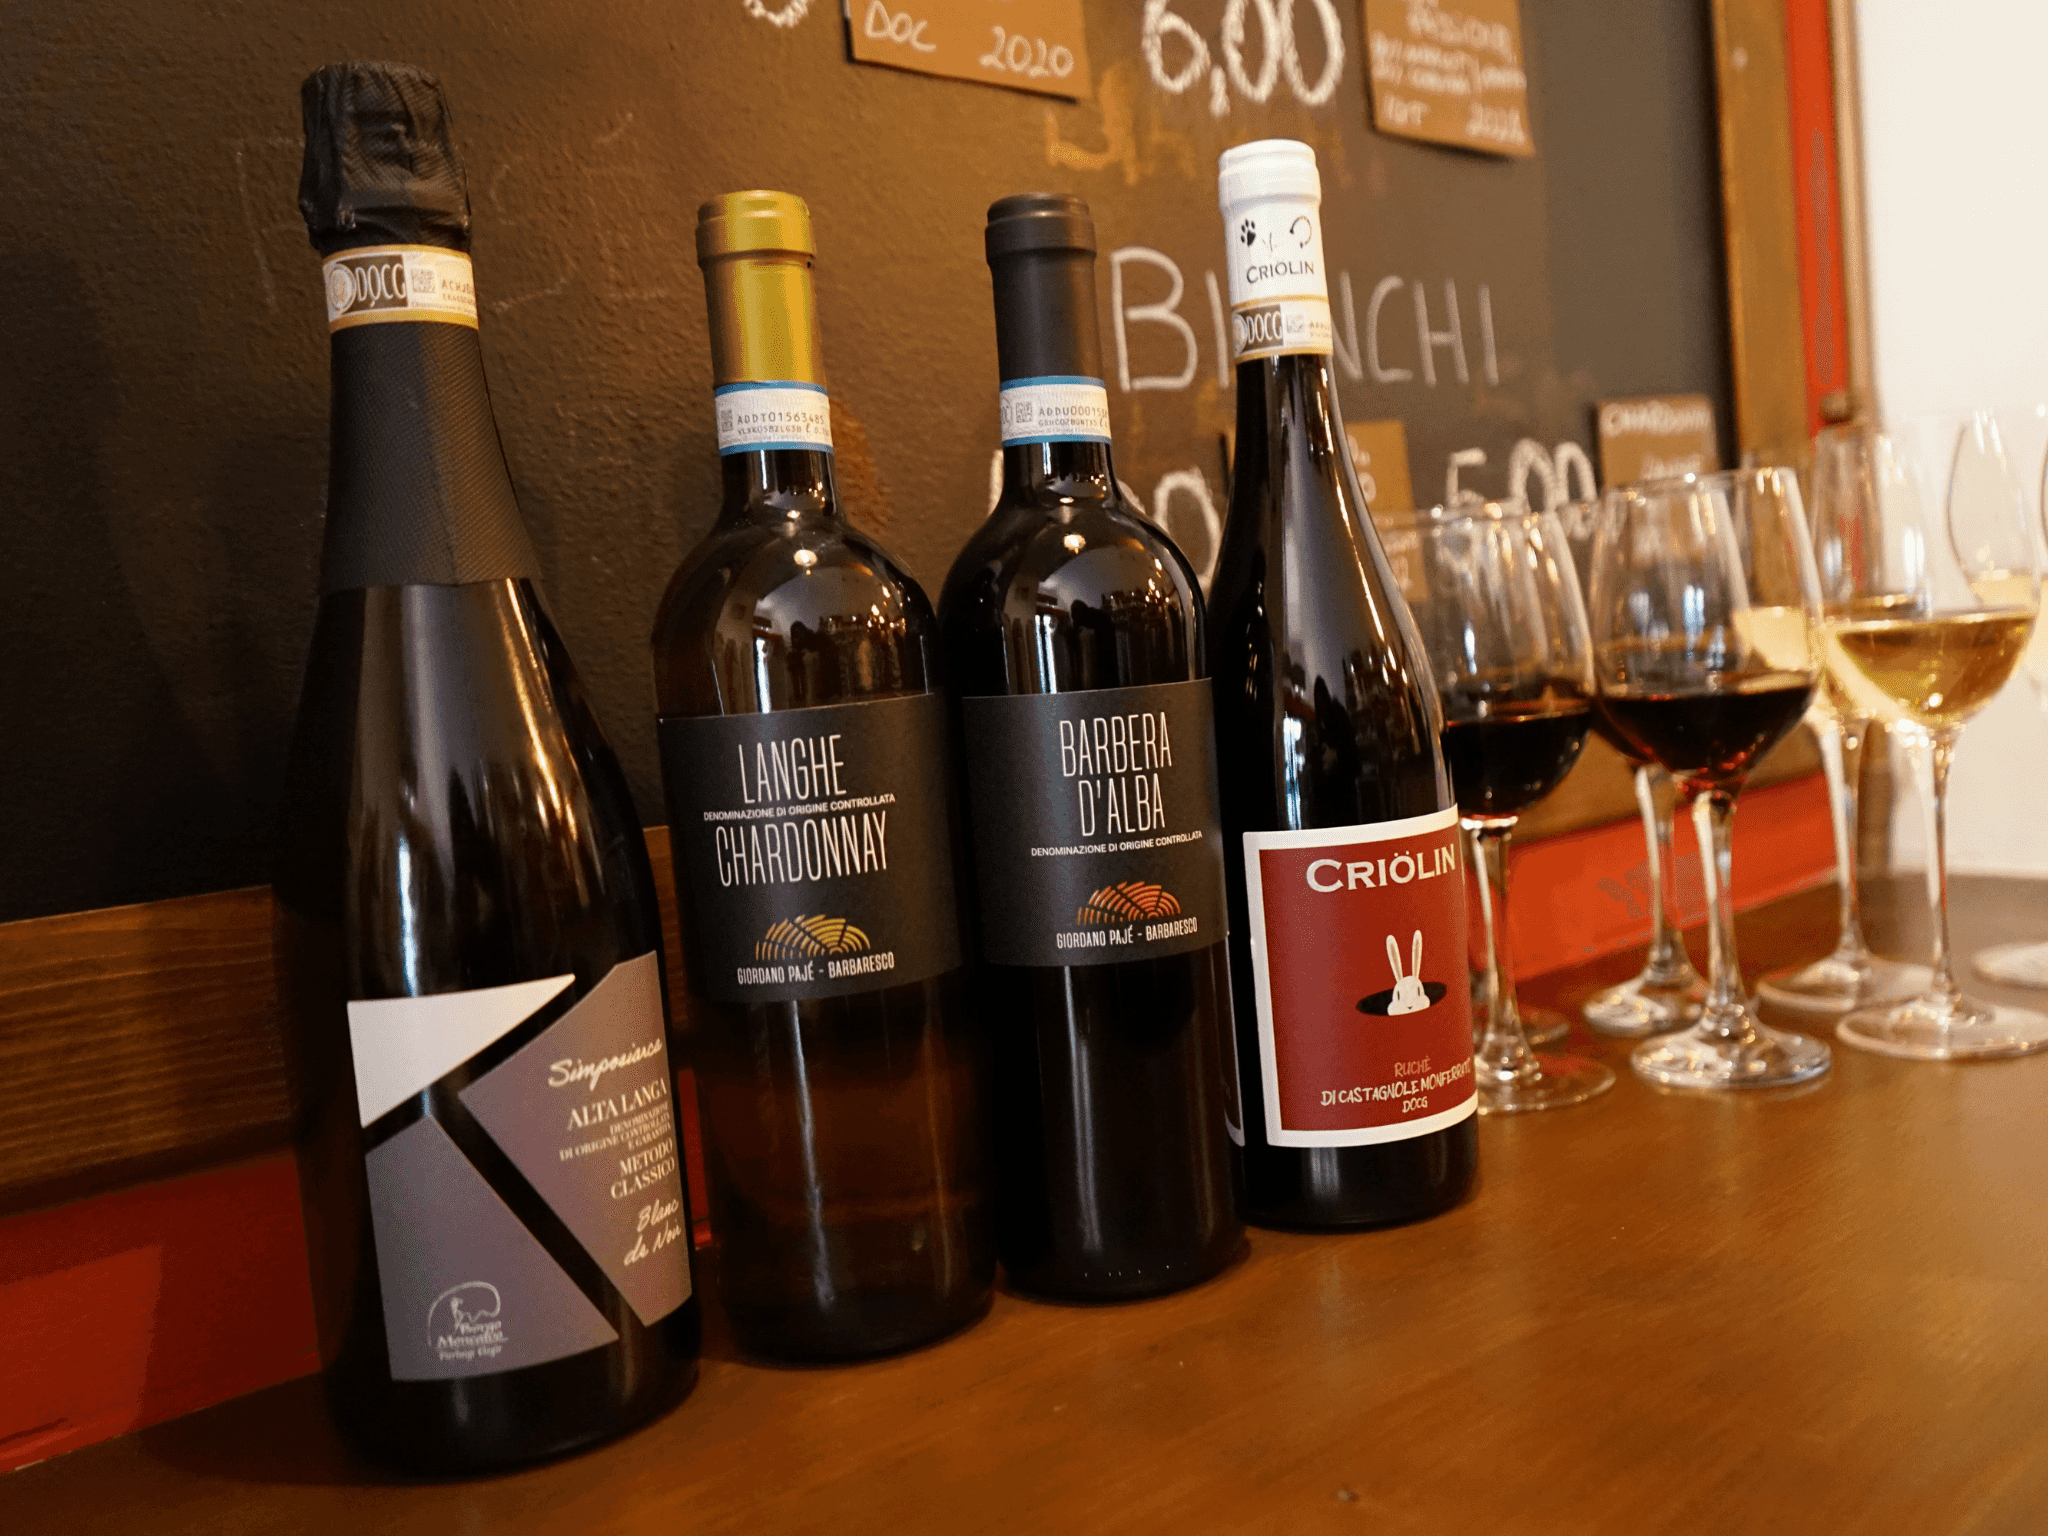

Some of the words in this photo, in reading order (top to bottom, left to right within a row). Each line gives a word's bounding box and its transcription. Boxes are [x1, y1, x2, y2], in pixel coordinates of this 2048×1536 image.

[865, 0, 936, 52] DOC
[978, 25, 1075, 78] 2020
[1142, 0, 1346, 118] 6,00
[355, 263, 408, 303] DOCG
[1246, 261, 1315, 284] CRIOLIN
[1111, 246, 1499, 391] BINCHI
[1246, 311, 1283, 344] DOCG
[1059, 711, 1172, 777] BARBERA
[738, 734, 847, 804] LANGHE
[703, 807, 775, 822] DENOMINAZIONE
[776, 806, 787, 818] DI
[789, 803, 829, 816] ORIGINE
[830, 793, 896, 811] CONTROLLATA
[1078, 773, 1166, 837] D'ALBA
[715, 810, 887, 887] CHARDONNAY
[1031, 842, 1107, 857] DENOMINAZIONE
[1108, 842, 1118, 852] DI
[1119, 838, 1155, 851] ORIGINE
[1155, 830, 1203, 846] CONTROLLATA
[1056, 931, 1107, 949] GIORDANO
[1109, 924, 1134, 944] PAJÉ
[1146, 916, 1199, 942] BARBARESCO
[737, 966, 785, 985] GIORDANO
[788, 960, 814, 982] PAJÉ
[828, 951, 895, 979] BARBARESCO
[566, 1098, 618, 1132] ALTA
[621, 1077, 668, 1114] LANGA
[1320, 1090, 1336, 1106] DI
[1338, 1080, 1420, 1104] CASTAGNOLE
[1402, 1096, 1428, 1113] DOCG
[620, 1138, 673, 1175] METODO
[611, 1157, 675, 1200] CLASSICO
[637, 1199, 679, 1233] Blanc
[624, 1234, 649, 1266] de
[652, 1219, 681, 1253] Noir
